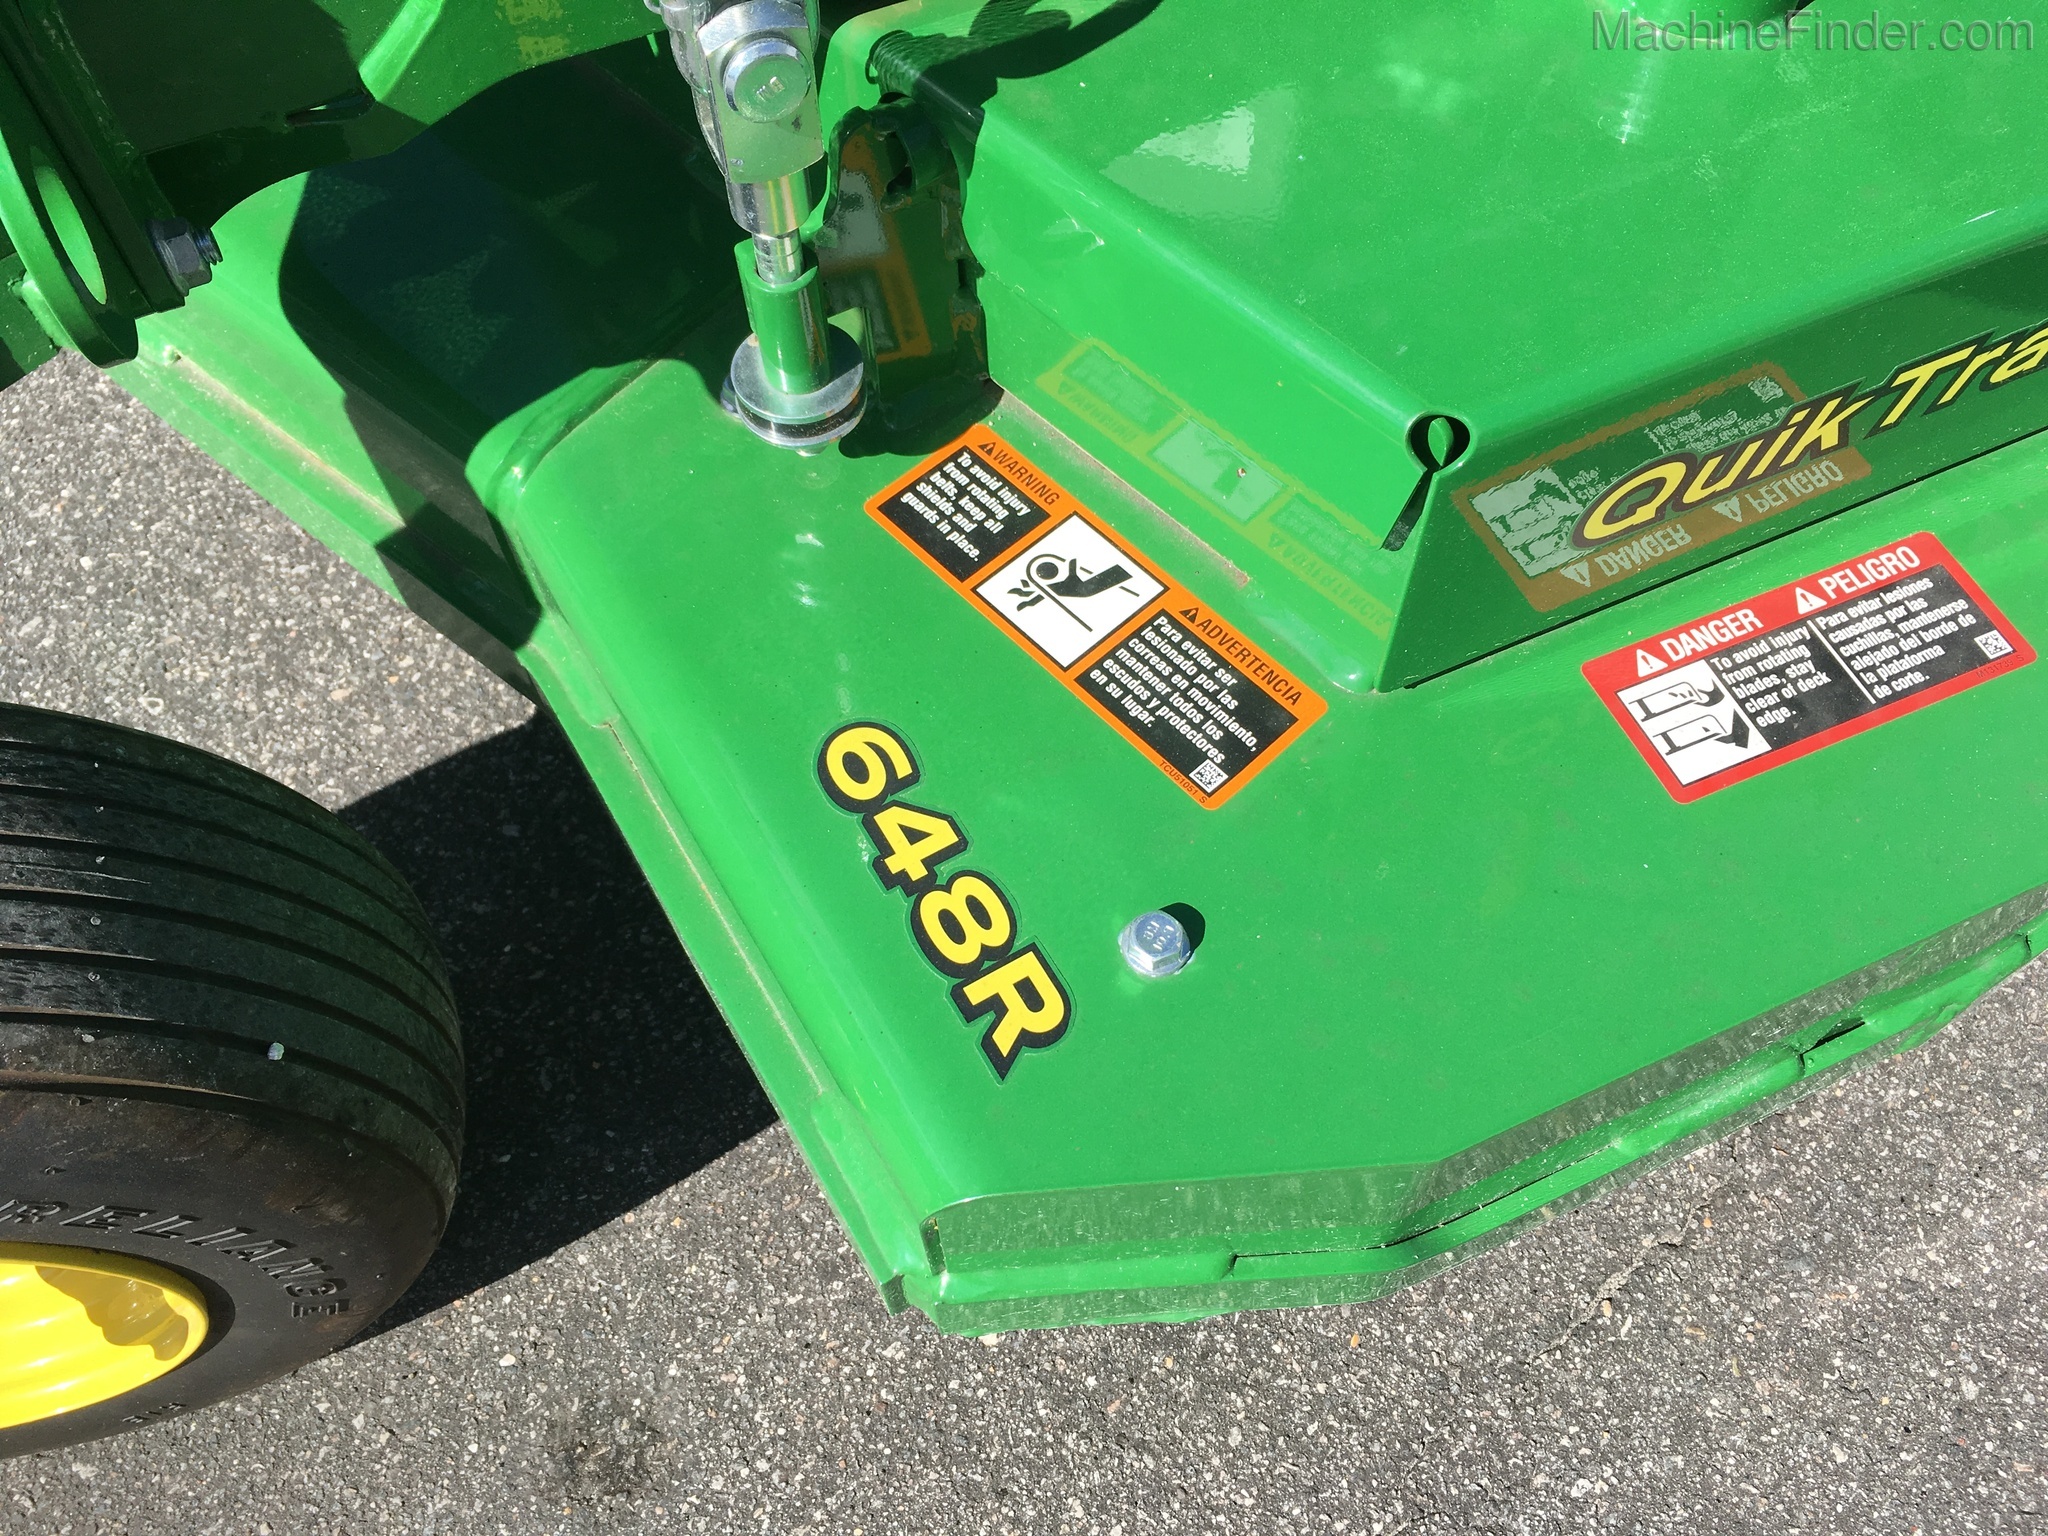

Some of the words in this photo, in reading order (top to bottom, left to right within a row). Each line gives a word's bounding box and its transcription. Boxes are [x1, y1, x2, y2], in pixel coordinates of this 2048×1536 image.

[928, 470, 958, 501] belts,
[956, 494, 987, 521] keep
[982, 517, 1005, 534] all
[941, 460, 970, 487] from
[965, 482, 1010, 521] rotating
[956, 450, 973, 468] To
[968, 463, 1003, 491] avoid
[996, 485, 1031, 517] injury
[991, 447, 1060, 506] WARNING
[899, 491, 940, 524] guards
[935, 518, 952, 535] in
[944, 529, 980, 562] place.
[915, 481, 956, 516] shields
[950, 512, 978, 533] and
[1816, 545, 1921, 600] PELIGRO
[1813, 610, 1850, 631] Para
[1845, 596, 1884, 619] evitar
[1878, 576, 1934, 605] lesiones
[1827, 612, 1888, 644] causadas
[1883, 603, 1908, 624] por
[1902, 596, 1929, 613] las
[1838, 627, 1901, 657] cuchillas,
[1895, 597, 1969, 634] mantenerse
[1152, 614, 1183, 644] Para
[1179, 639, 1218, 670] evitar
[1213, 667, 1238, 687] ser
[1194, 617, 1302, 706] ADVERTENCIA
[1658, 607, 1764, 662] DANGER
[1708, 655, 1733, 671] To
[1731, 638, 1772, 664] avoid
[1767, 624, 1811, 649] injury
[1849, 643, 1900, 671] alejado
[1897, 632, 1923, 652] del
[1916, 619, 1959, 643] borde
[1956, 612, 1977, 628] de
[1858, 670, 1879, 685] la
[1875, 643, 1946, 681] plataforma
[1114, 646, 1173, 696] mantener
[1167, 690, 1204, 724] todos
[1200, 718, 1224, 741] los
[1139, 624, 1198, 676] lesionado
[1191, 672, 1220, 693] por
[1215, 687, 1239, 710] las
[1720, 664, 1758, 686] from
[1755, 643, 1812, 673] rotating
[1730, 672, 1787, 700] blades,
[1783, 658, 1816, 679] stay
[1743, 690, 1781, 714] clear
[1779, 681, 1798, 699] of
[1795, 669, 1832, 693] deck
[1871, 683, 1893, 699] de
[1889, 670, 1930, 692] corte.
[1088, 668, 1108, 686] en
[1104, 681, 1124, 699] su
[1119, 692, 1156, 728] lugar.
[1101, 657, 1151, 701] escudos
[1144, 696, 1161, 709] y
[1153, 704, 1226, 769] protectores
[1127, 637, 1173, 677] correas
[1169, 672, 1190, 691] en
[1185, 686, 1257, 752] movimiento,
[1754, 705, 1797, 728] edge.
[820, 723, 1069, 1066] 648R
[0, 1199, 345, 1318] RELIANCE
